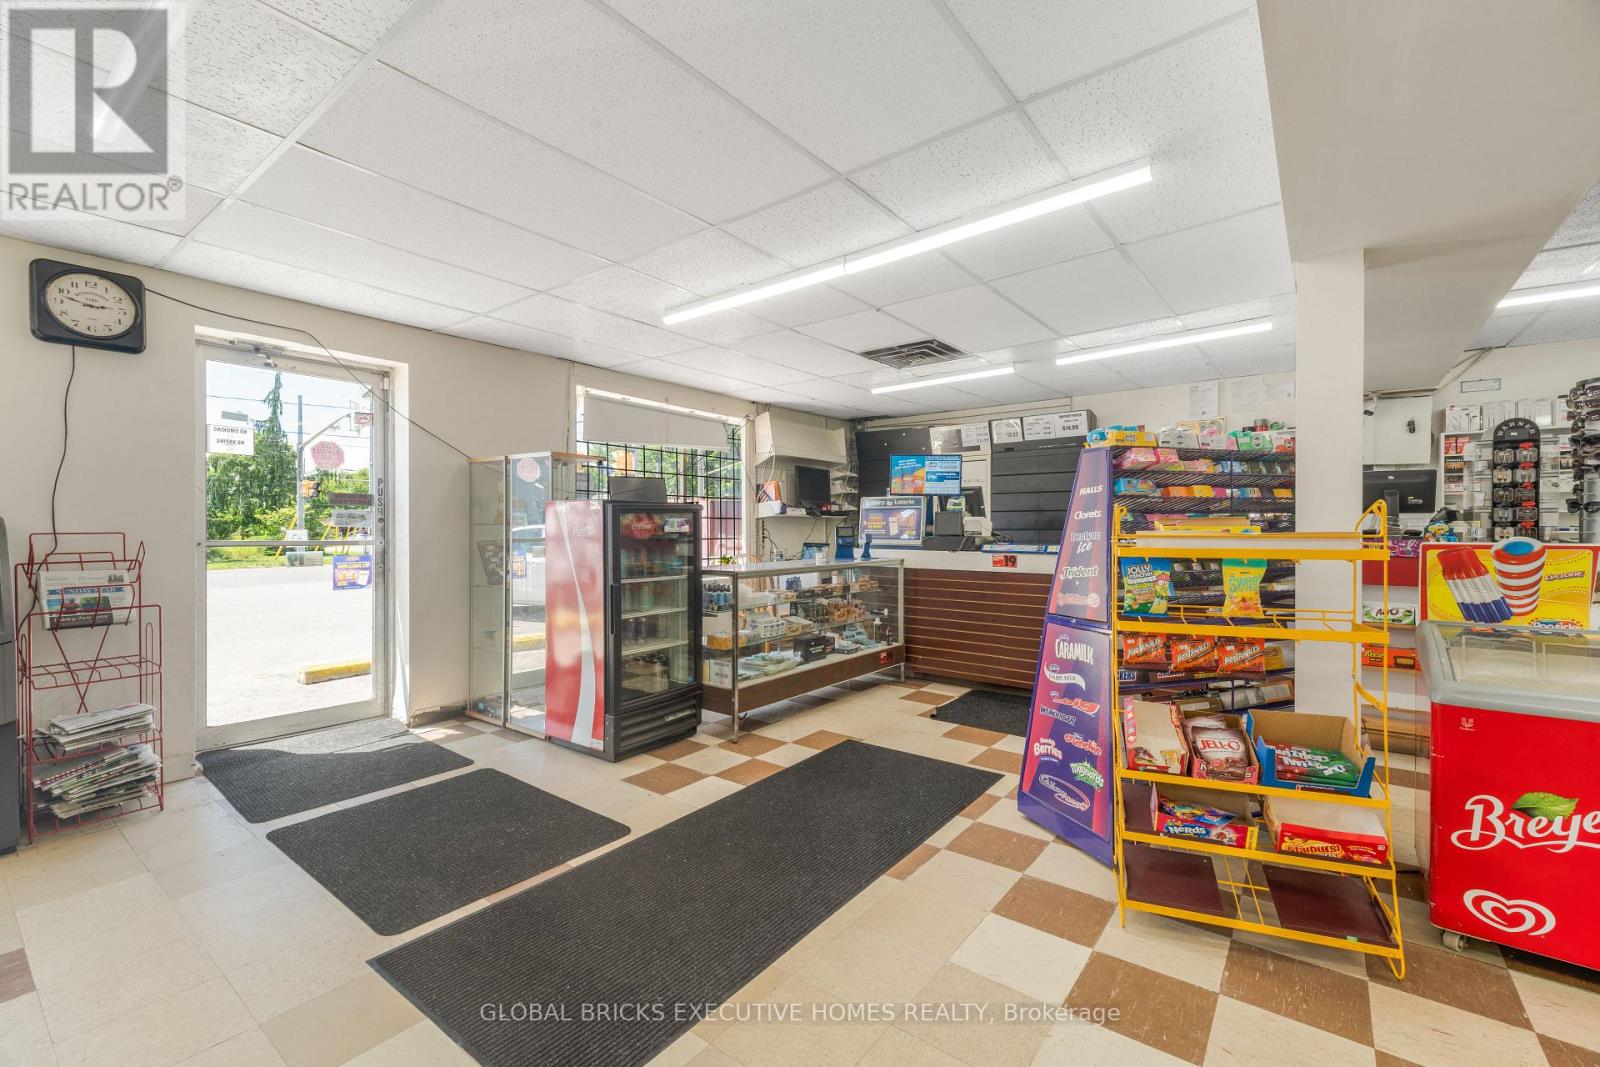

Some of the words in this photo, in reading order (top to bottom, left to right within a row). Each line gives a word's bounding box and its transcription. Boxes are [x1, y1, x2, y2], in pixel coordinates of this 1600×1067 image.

[1079, 484, 1103, 496] HALLS
[1074, 510, 1102, 520] Clorets
[1004, 554, 1016, 567] 19
[1061, 565, 1099, 578] Trident
[1128, 563, 1152, 574] JOLLY
[1055, 638, 1094, 665] CARAMILK
[1034, 742, 1062, 760] Berries
[1200, 738, 1241, 752] JELL-O
